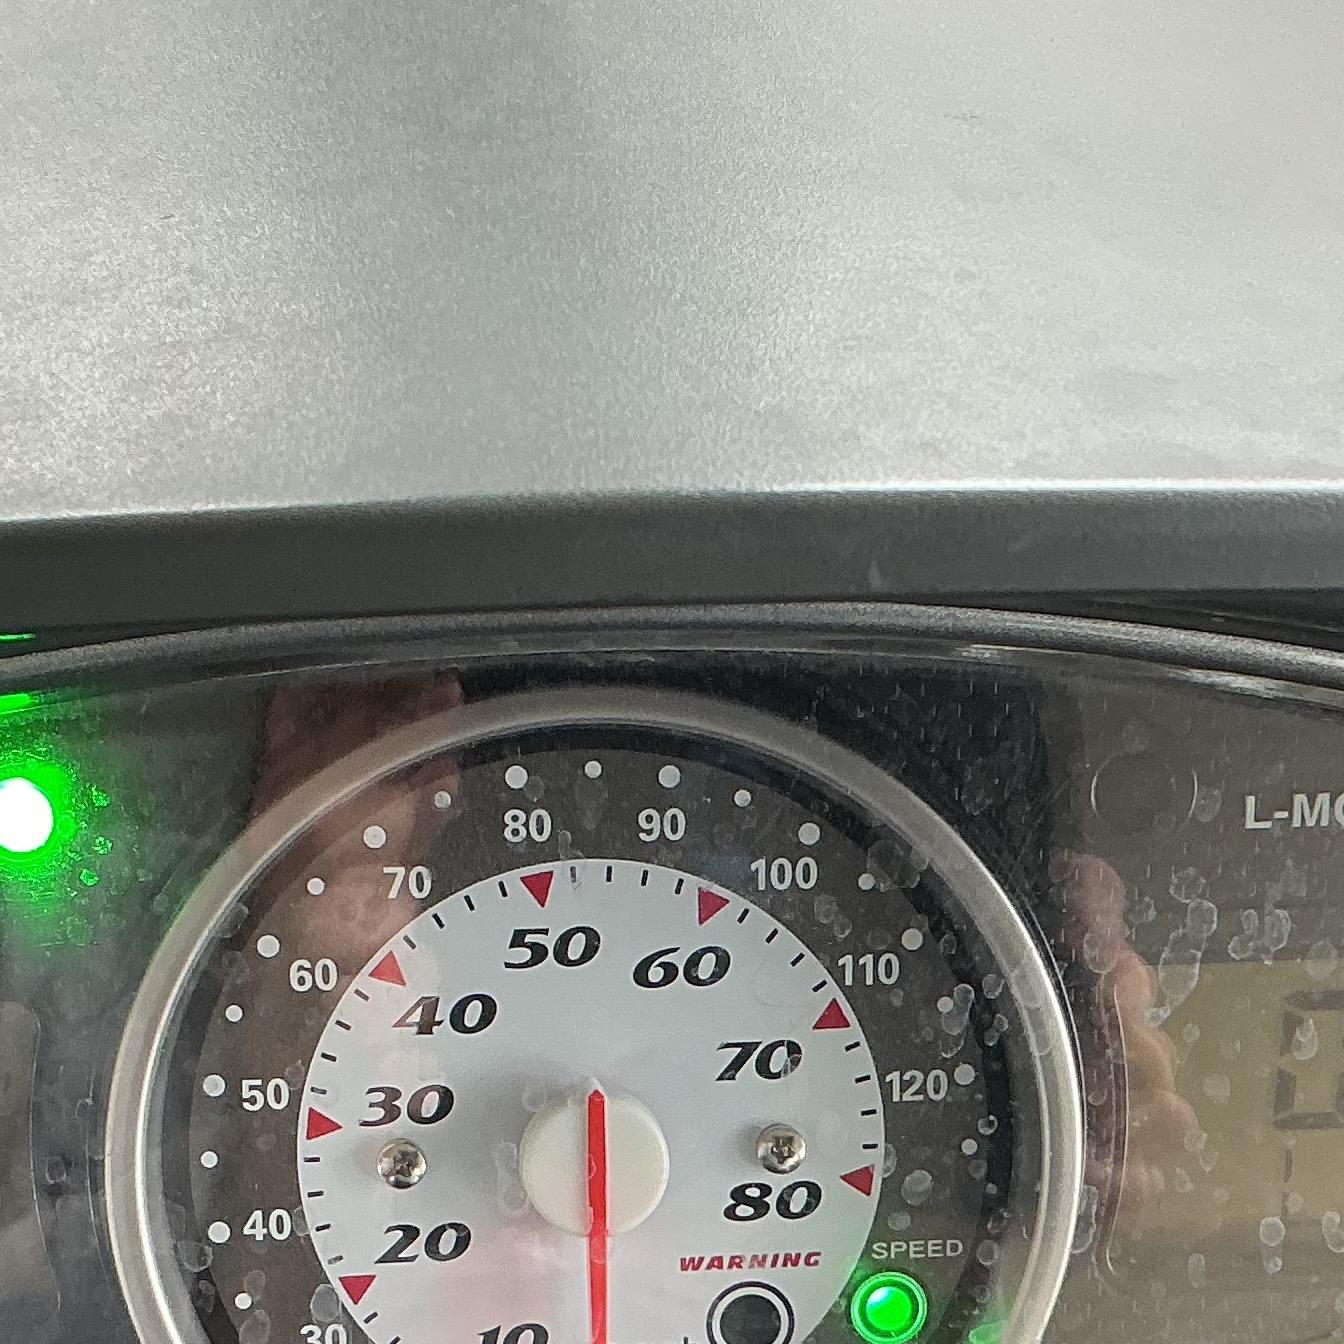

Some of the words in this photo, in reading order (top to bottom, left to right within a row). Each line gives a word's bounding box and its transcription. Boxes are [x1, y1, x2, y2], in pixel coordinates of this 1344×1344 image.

[502, 808, 553, 844] 80
[637, 807, 687, 843] 90
[382, 865, 433, 900] 70
[750, 856, 818, 891] 100
[503, 925, 602, 970] 50
[288, 959, 338, 993] 60
[631, 945, 732, 989] 60
[838, 953, 900, 987] 110
[392, 993, 498, 1036] 40
[715, 1039, 803, 1082] 70
[240, 1077, 291, 1112] 50
[885, 1069, 948, 1104] 120
[358, 1084, 456, 1128] 30
[723, 1180, 823, 1222] 80
[242, 1208, 292, 1242] 40
[374, 1221, 472, 1265] 20
[871, 1239, 964, 1260] SPEED
[678, 1251, 823, 1273] WARNING
